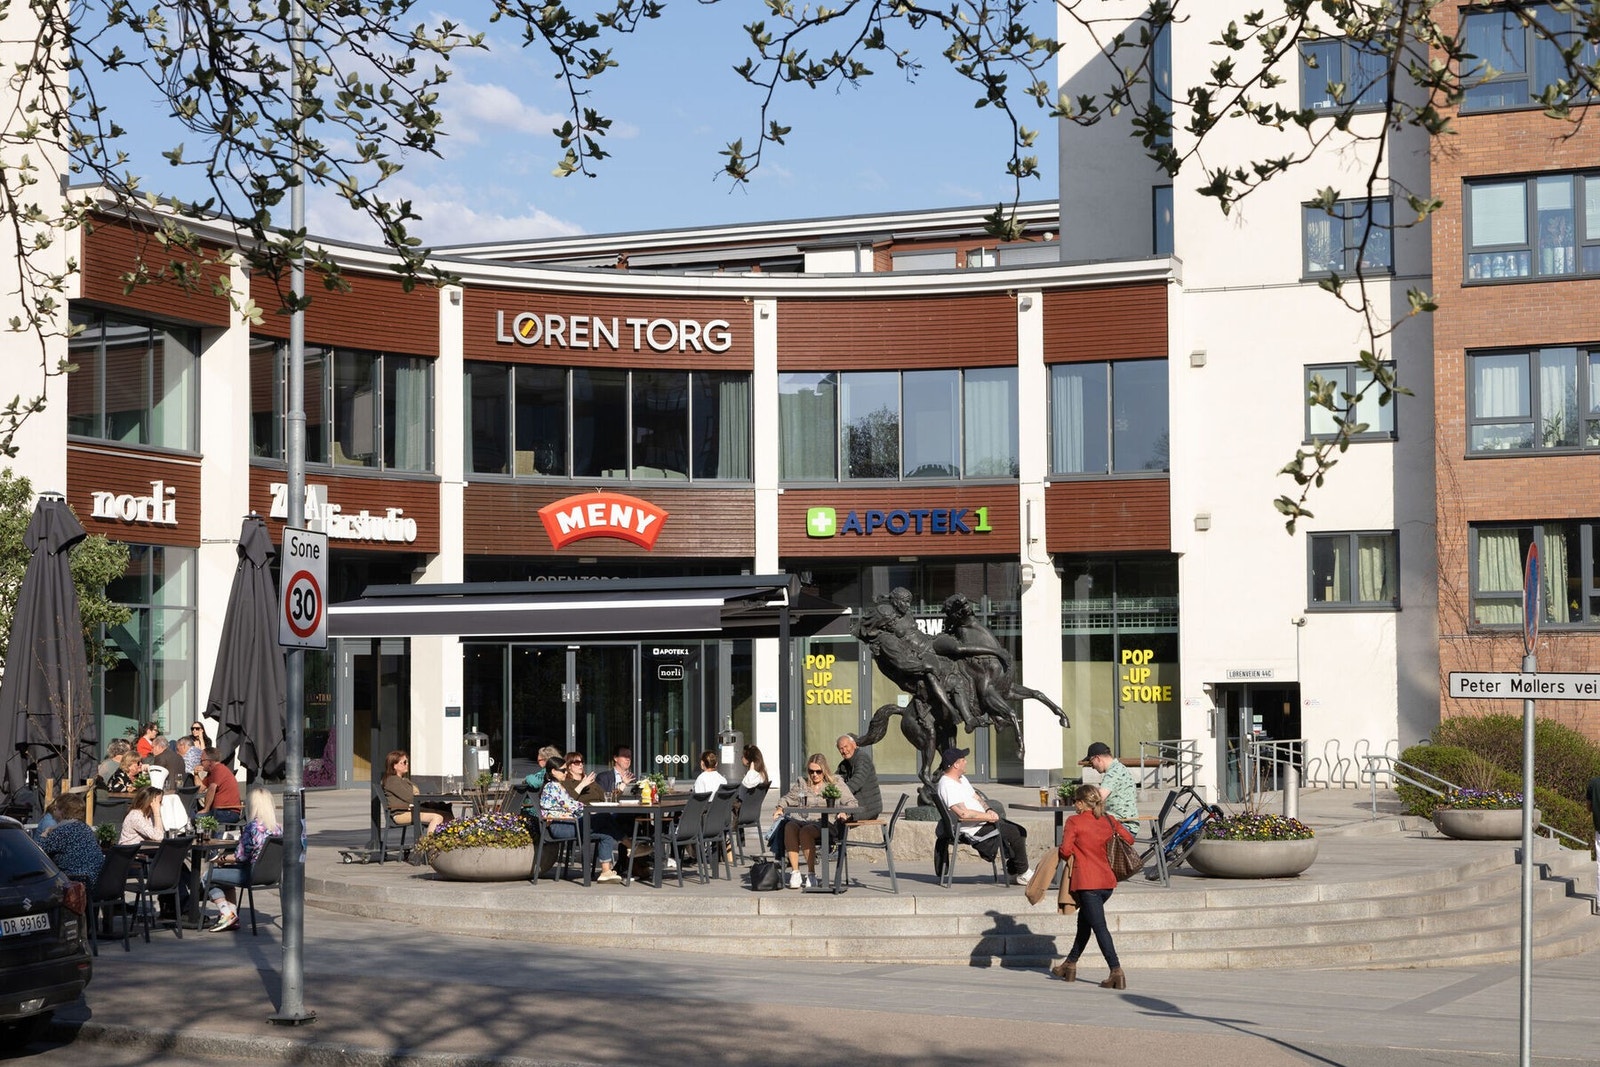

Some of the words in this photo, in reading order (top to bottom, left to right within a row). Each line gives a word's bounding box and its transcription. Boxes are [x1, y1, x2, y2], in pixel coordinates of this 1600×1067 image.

[626, 317, 732, 352] TORG
[90, 480, 178, 525] norli
[555, 502, 657, 534] MENY
[290, 536, 320, 559] Sone
[292, 587, 316, 621] 30
[806, 654, 836, 670] POP
[1121, 649, 1154, 666] POP
[660, 668, 682, 677] norli
[806, 671, 833, 687] -UP
[1122, 667, 1151, 684] -UP
[1121, 685, 1172, 702] STORE
[1460, 678, 1501, 693] Peter
[1510, 679, 1565, 694] Møllers
[1574, 680, 1597, 694] vei
[806, 688, 853, 705] STORE
[3, 920, 17, 934] DR
[20, 915, 47, 931] 99169
